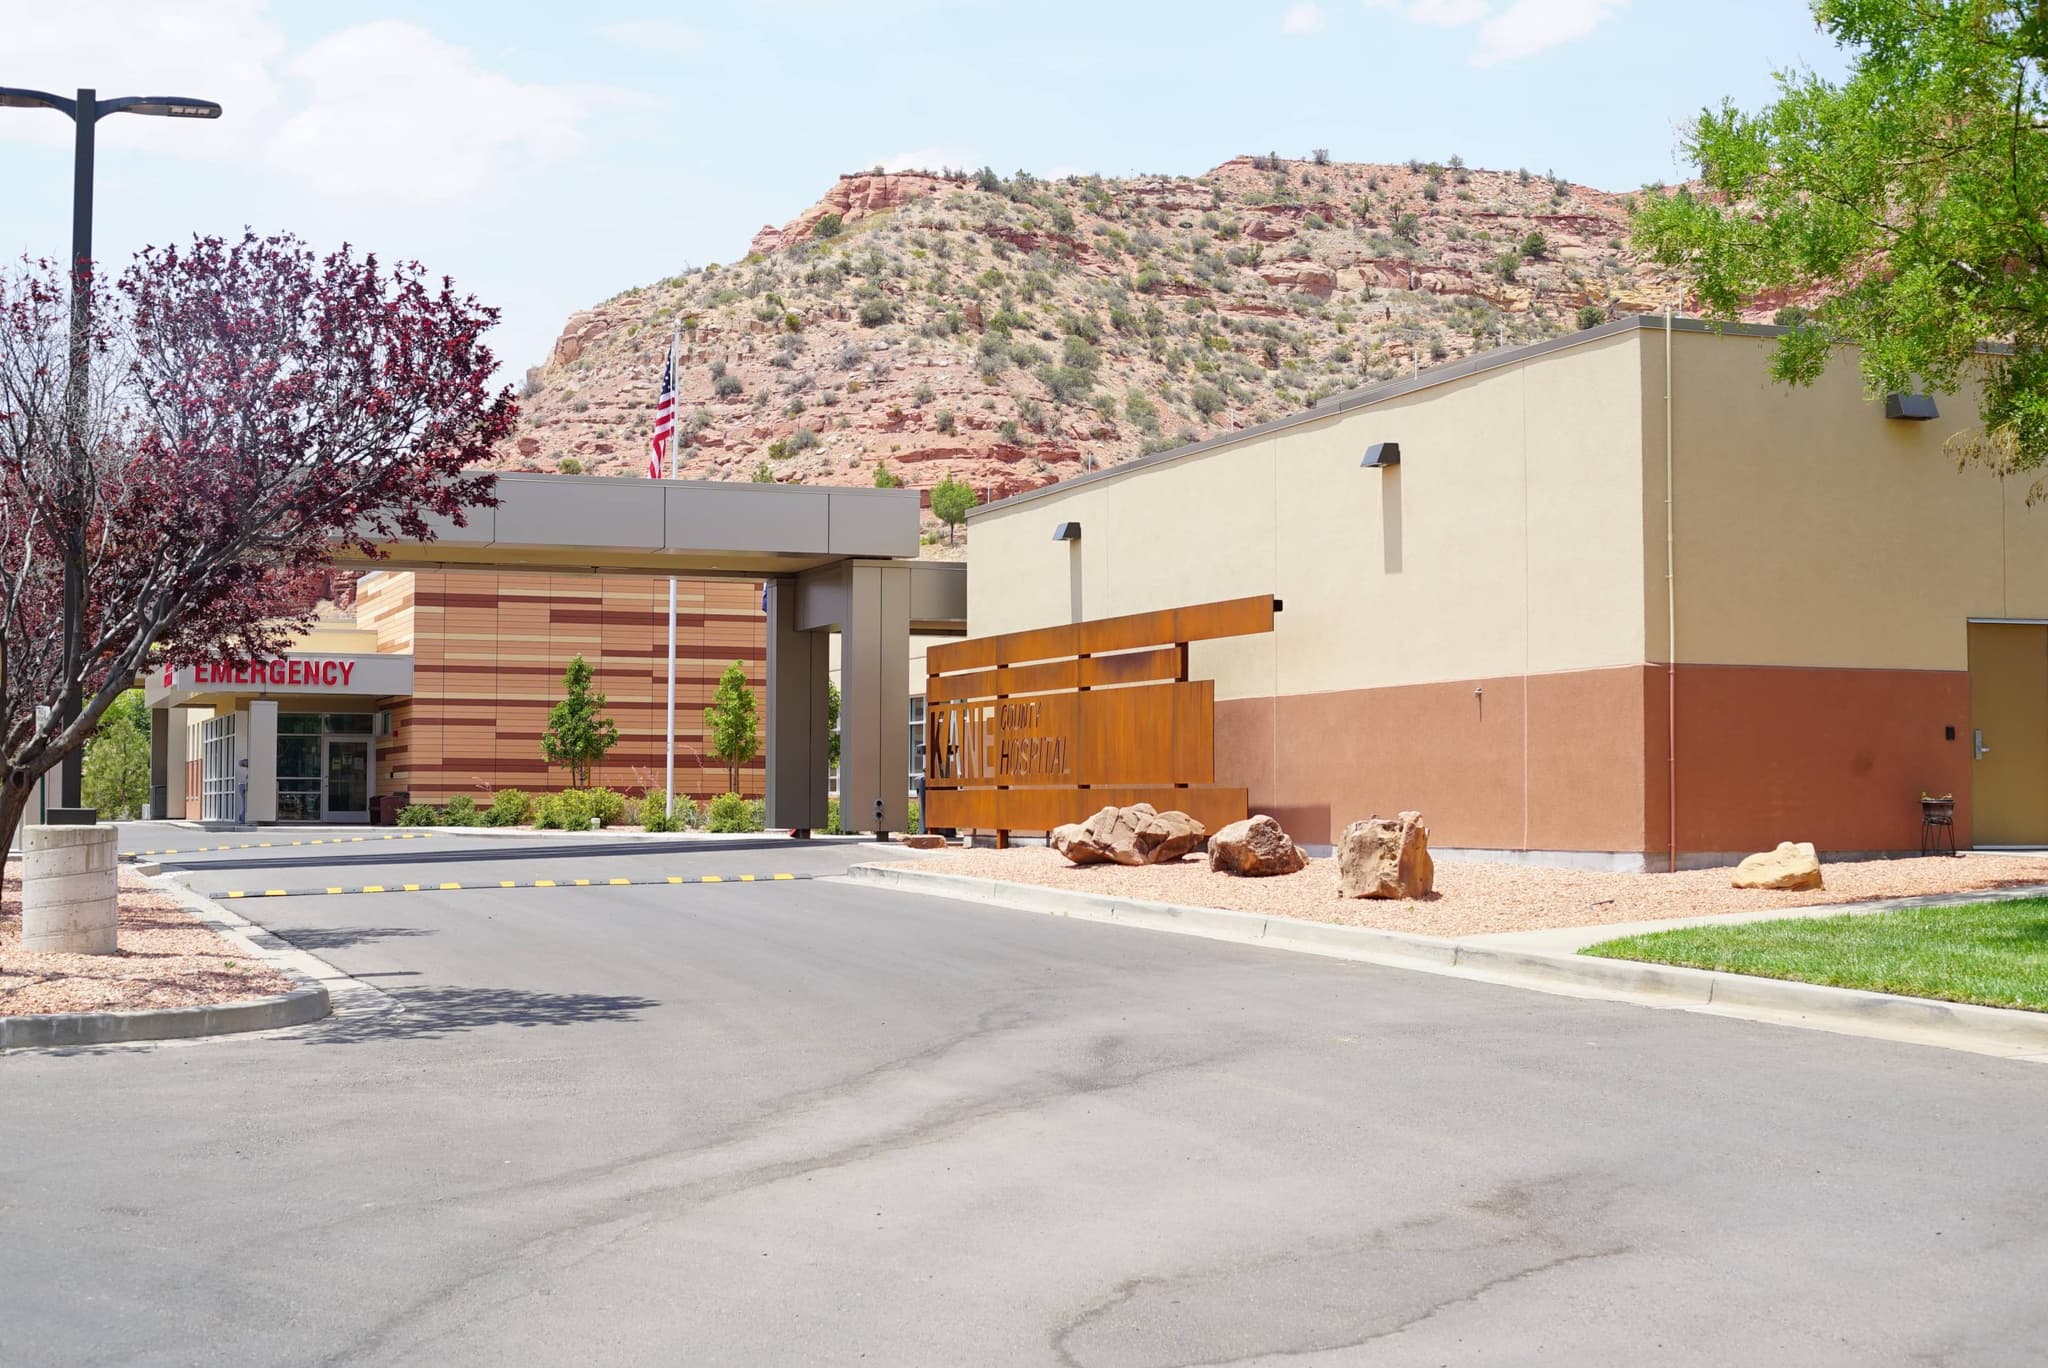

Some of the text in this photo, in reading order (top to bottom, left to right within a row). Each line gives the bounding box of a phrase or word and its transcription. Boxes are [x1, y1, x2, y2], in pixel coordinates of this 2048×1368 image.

[194, 659, 355, 686] EMERGENCY
[1001, 702, 1042, 731] COUNTY
[930, 706, 995, 779] KANE
[1000, 736, 1071, 776] HOSPITAL
